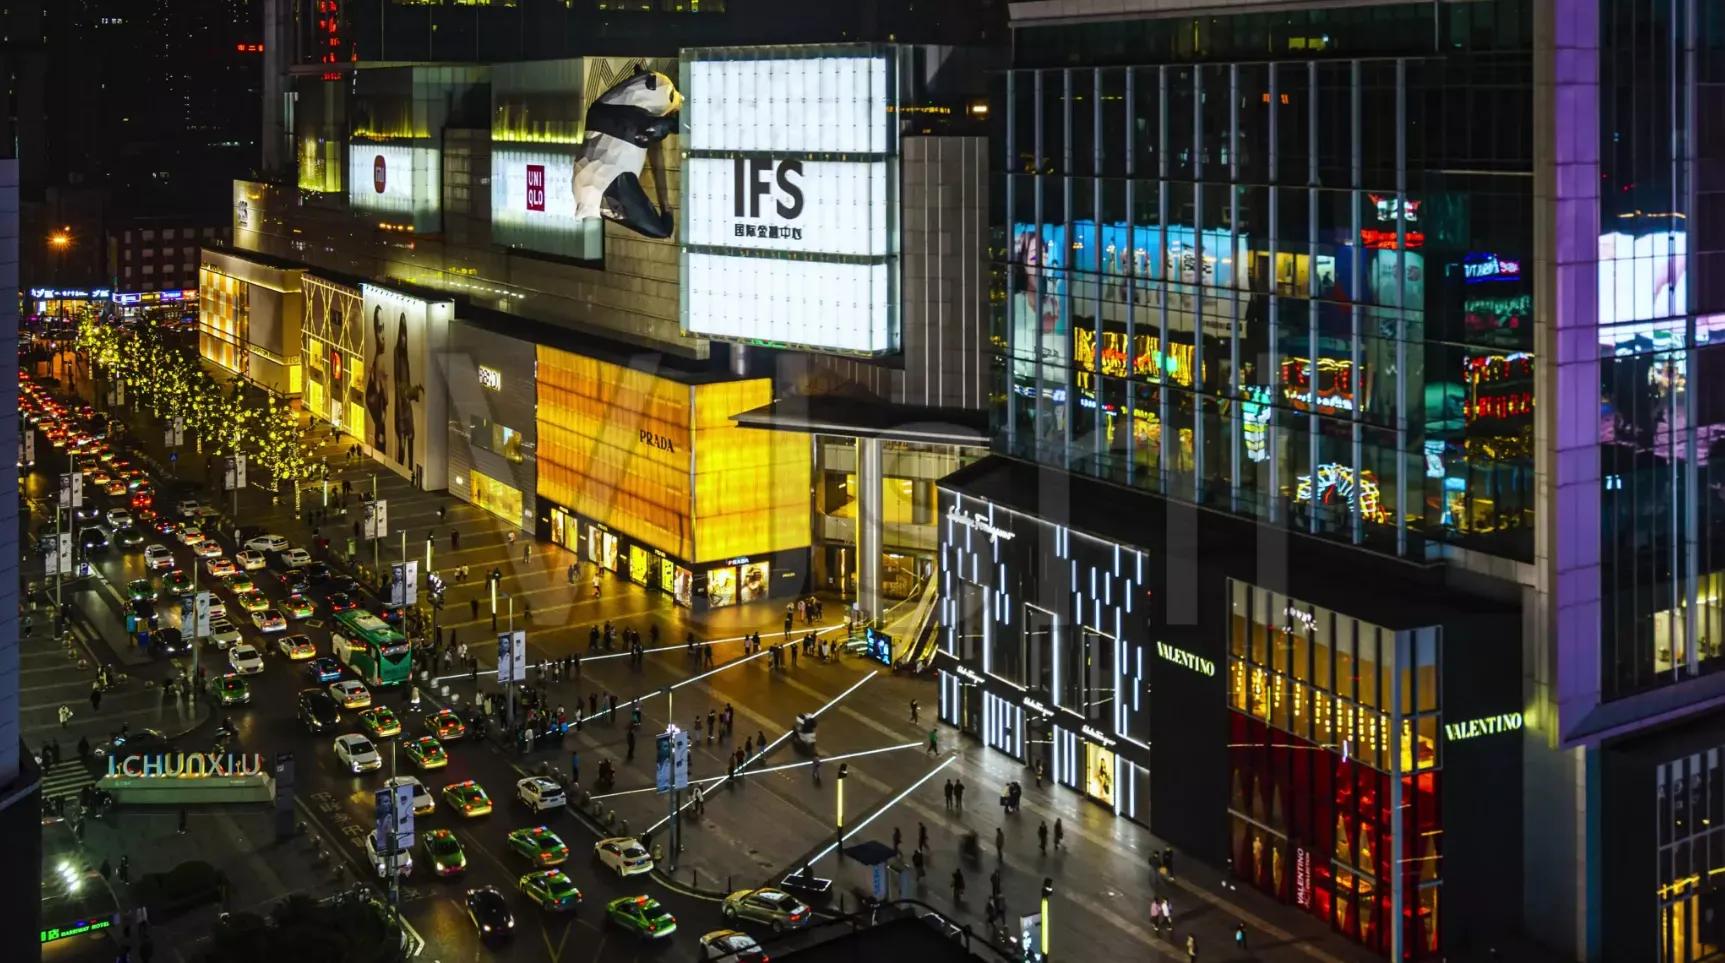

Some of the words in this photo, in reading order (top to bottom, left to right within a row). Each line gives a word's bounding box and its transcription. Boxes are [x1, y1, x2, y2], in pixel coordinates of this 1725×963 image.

[528, 171, 542, 187] UNI
[735, 158, 804, 220] IFS
[528, 190, 543, 206] QLO
[640, 429, 675, 453] PRADA
[1156, 641, 1216, 677] VALENTINO
[1445, 712, 1522, 741] VALENTINO
[1296, 848, 1304, 905] VALENTINO
